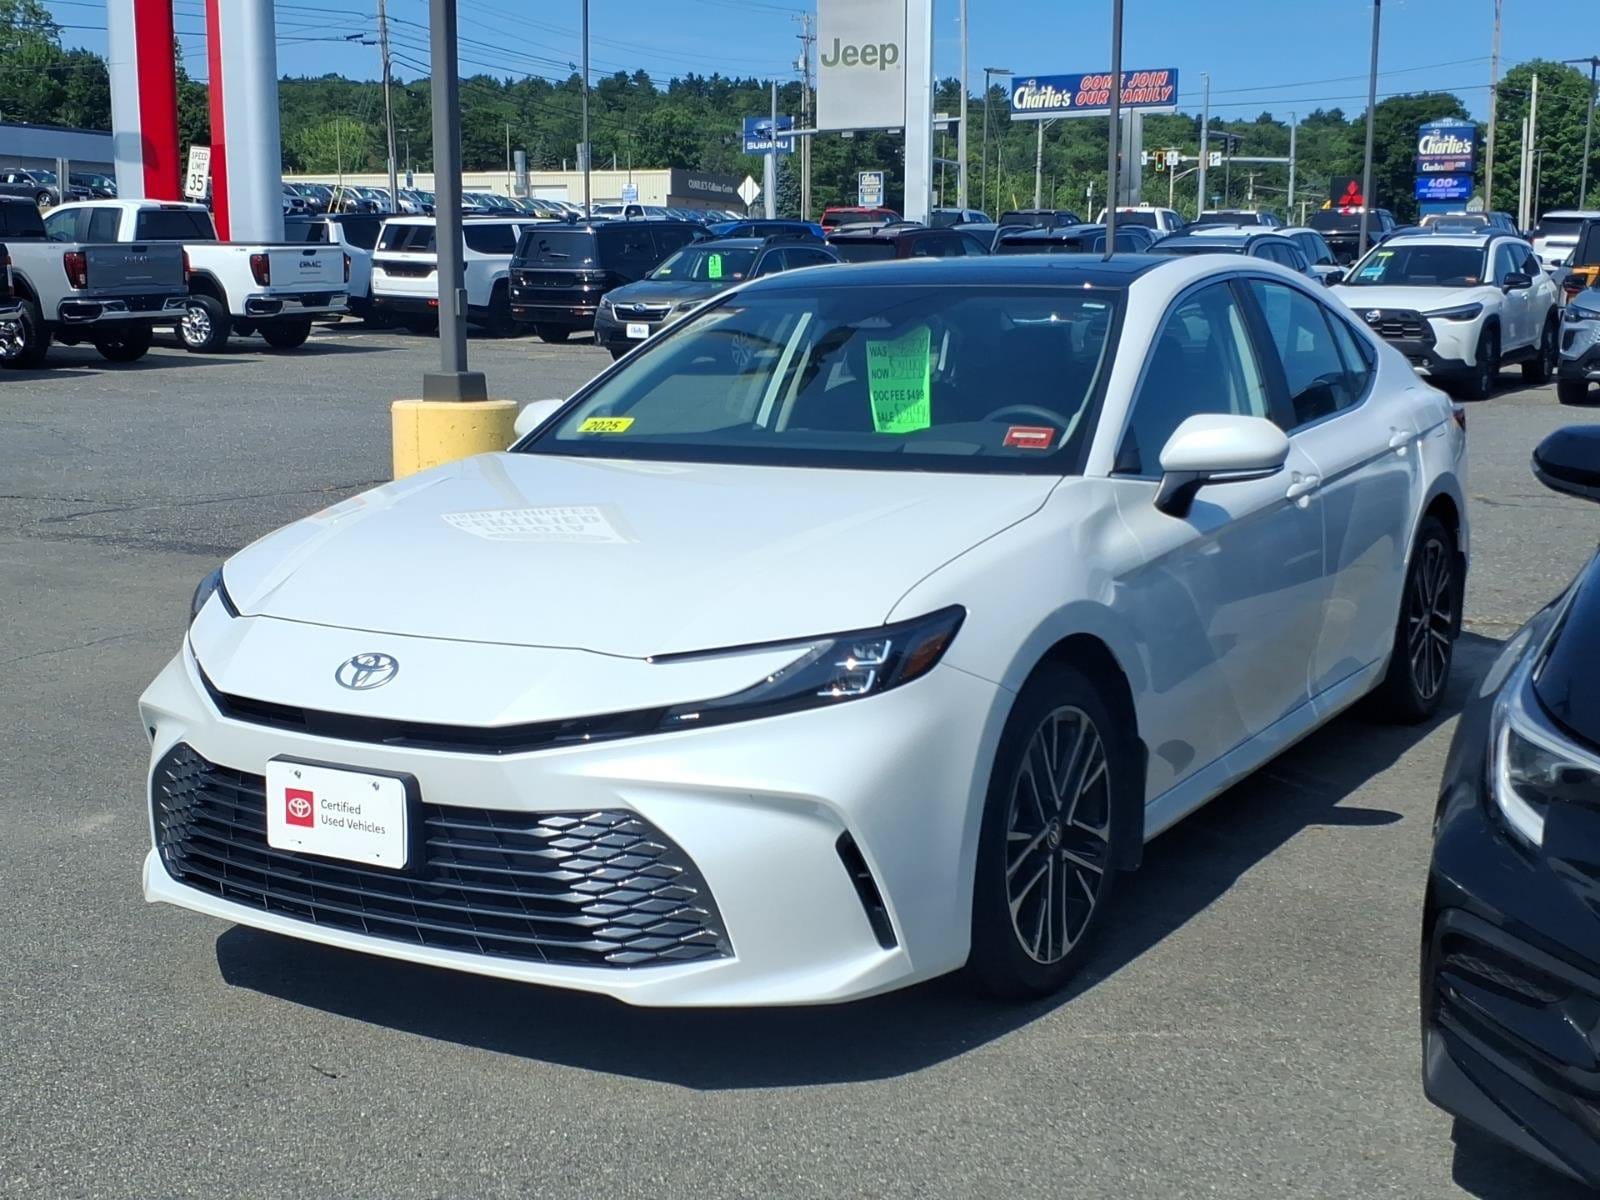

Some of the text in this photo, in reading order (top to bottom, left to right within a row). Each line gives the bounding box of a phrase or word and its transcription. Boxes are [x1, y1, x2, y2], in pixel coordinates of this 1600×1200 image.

[820, 37, 899, 71] Jeep
[1127, 71, 1168, 89] JOIN
[1013, 86, 1071, 110] Charlie's
[1075, 86, 1173, 106] OUR AMILY
[1418, 134, 1472, 155] Charlie's
[191, 151, 209, 160] SPEED
[191, 161, 206, 170] LIMIT
[189, 173, 205, 192] 35
[1428, 178, 1458, 188] 400+
[299, 260, 322, 269] GMC
[869, 345, 888, 357] WAS
[871, 368, 889, 380] NOW
[873, 389, 890, 401] DOC
[890, 389, 905, 401] FEE
[876, 410, 895, 422] SALE
[584, 420, 622, 431] 2025
[320, 798, 362, 815] Certified
[321, 814, 385, 834] Used Vehicles
